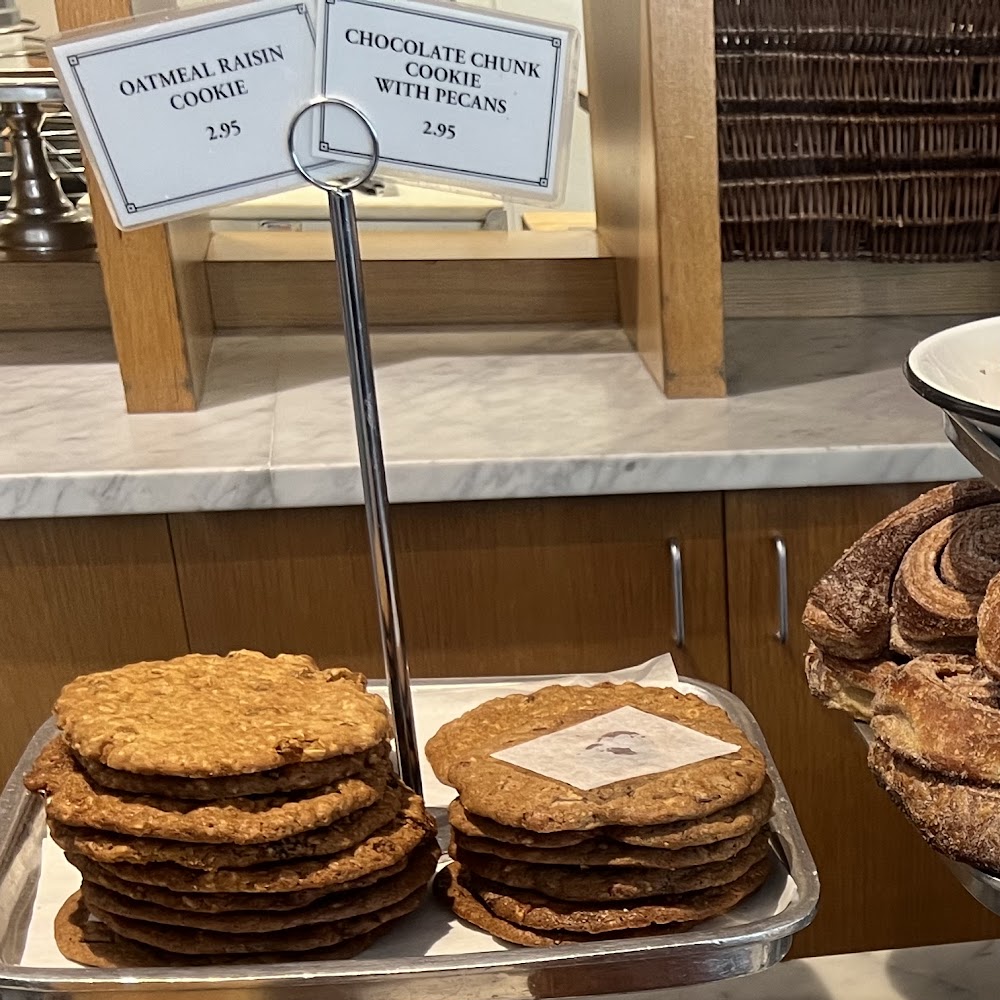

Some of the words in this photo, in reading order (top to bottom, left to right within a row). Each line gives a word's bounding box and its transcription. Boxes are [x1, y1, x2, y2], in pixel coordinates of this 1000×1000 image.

[345, 28, 466, 64] CHOCOLATE
[470, 52, 541, 79] CHUNK
[119, 62, 215, 96] OATMEAL
[217, 45, 285, 73] RAISIN
[405, 61, 482, 88] COOKIE
[170, 79, 249, 110] COOKIE
[374, 76, 429, 101] WITH
[436, 87, 507, 114] PECANS
[206, 120, 241, 141] 2.95
[423, 121, 455, 139] 2.95
